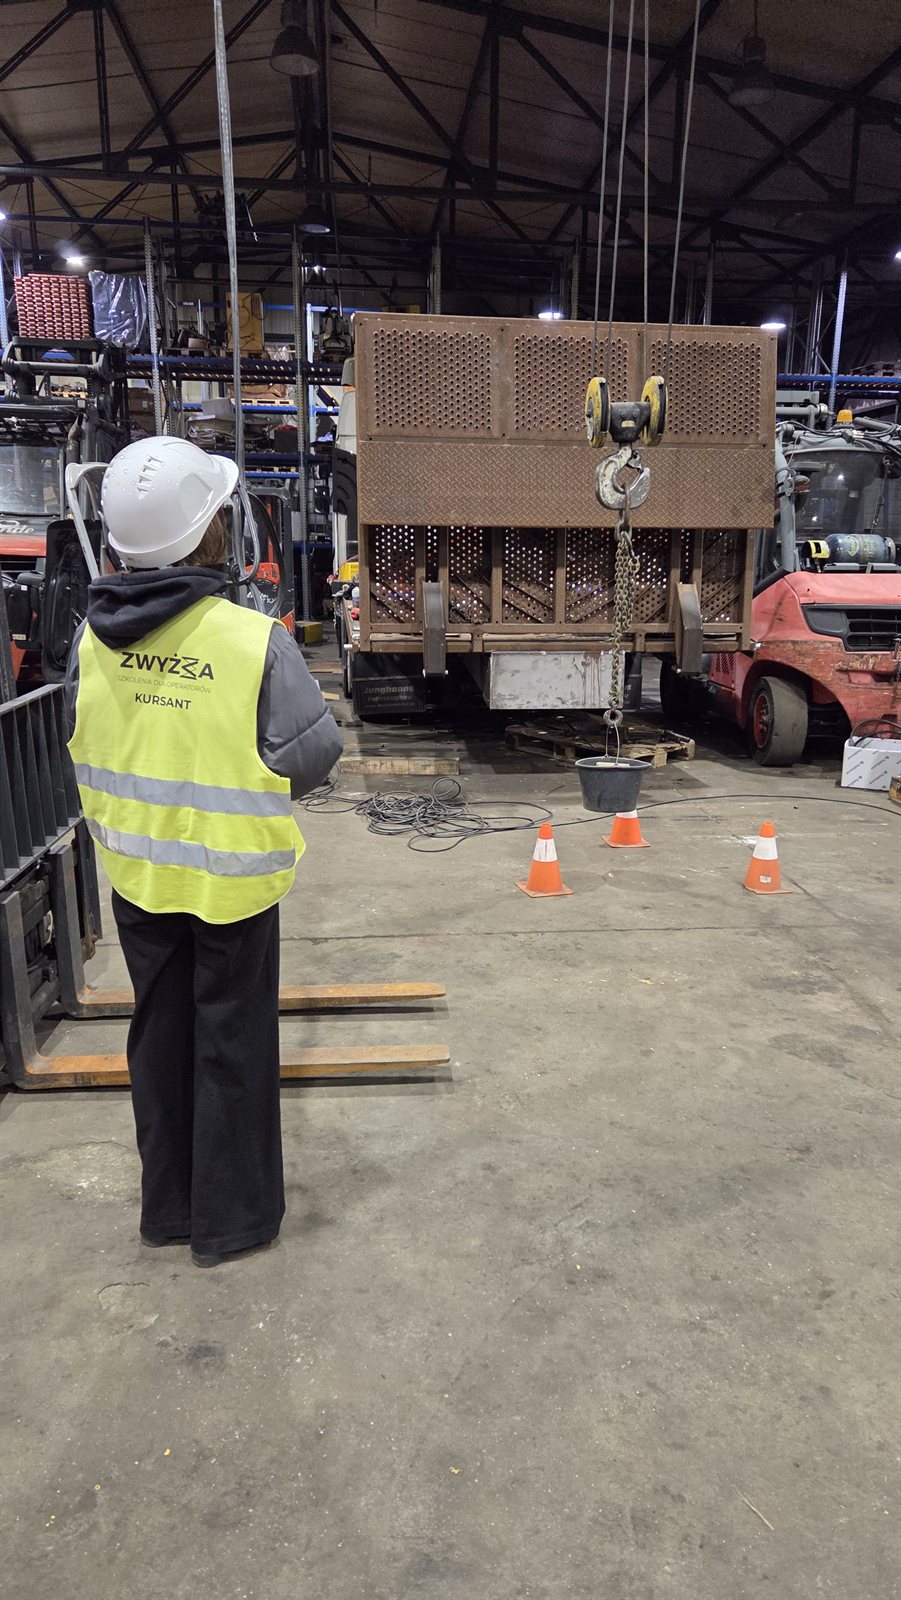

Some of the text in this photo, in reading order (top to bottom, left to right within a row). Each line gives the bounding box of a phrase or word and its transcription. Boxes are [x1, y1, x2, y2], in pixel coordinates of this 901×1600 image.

[116, 675, 211, 694] SZKOLENIA DLA OPERATORÓW
[363, 686, 415, 695] Junghanns
[135, 692, 191, 710] KURSANT
